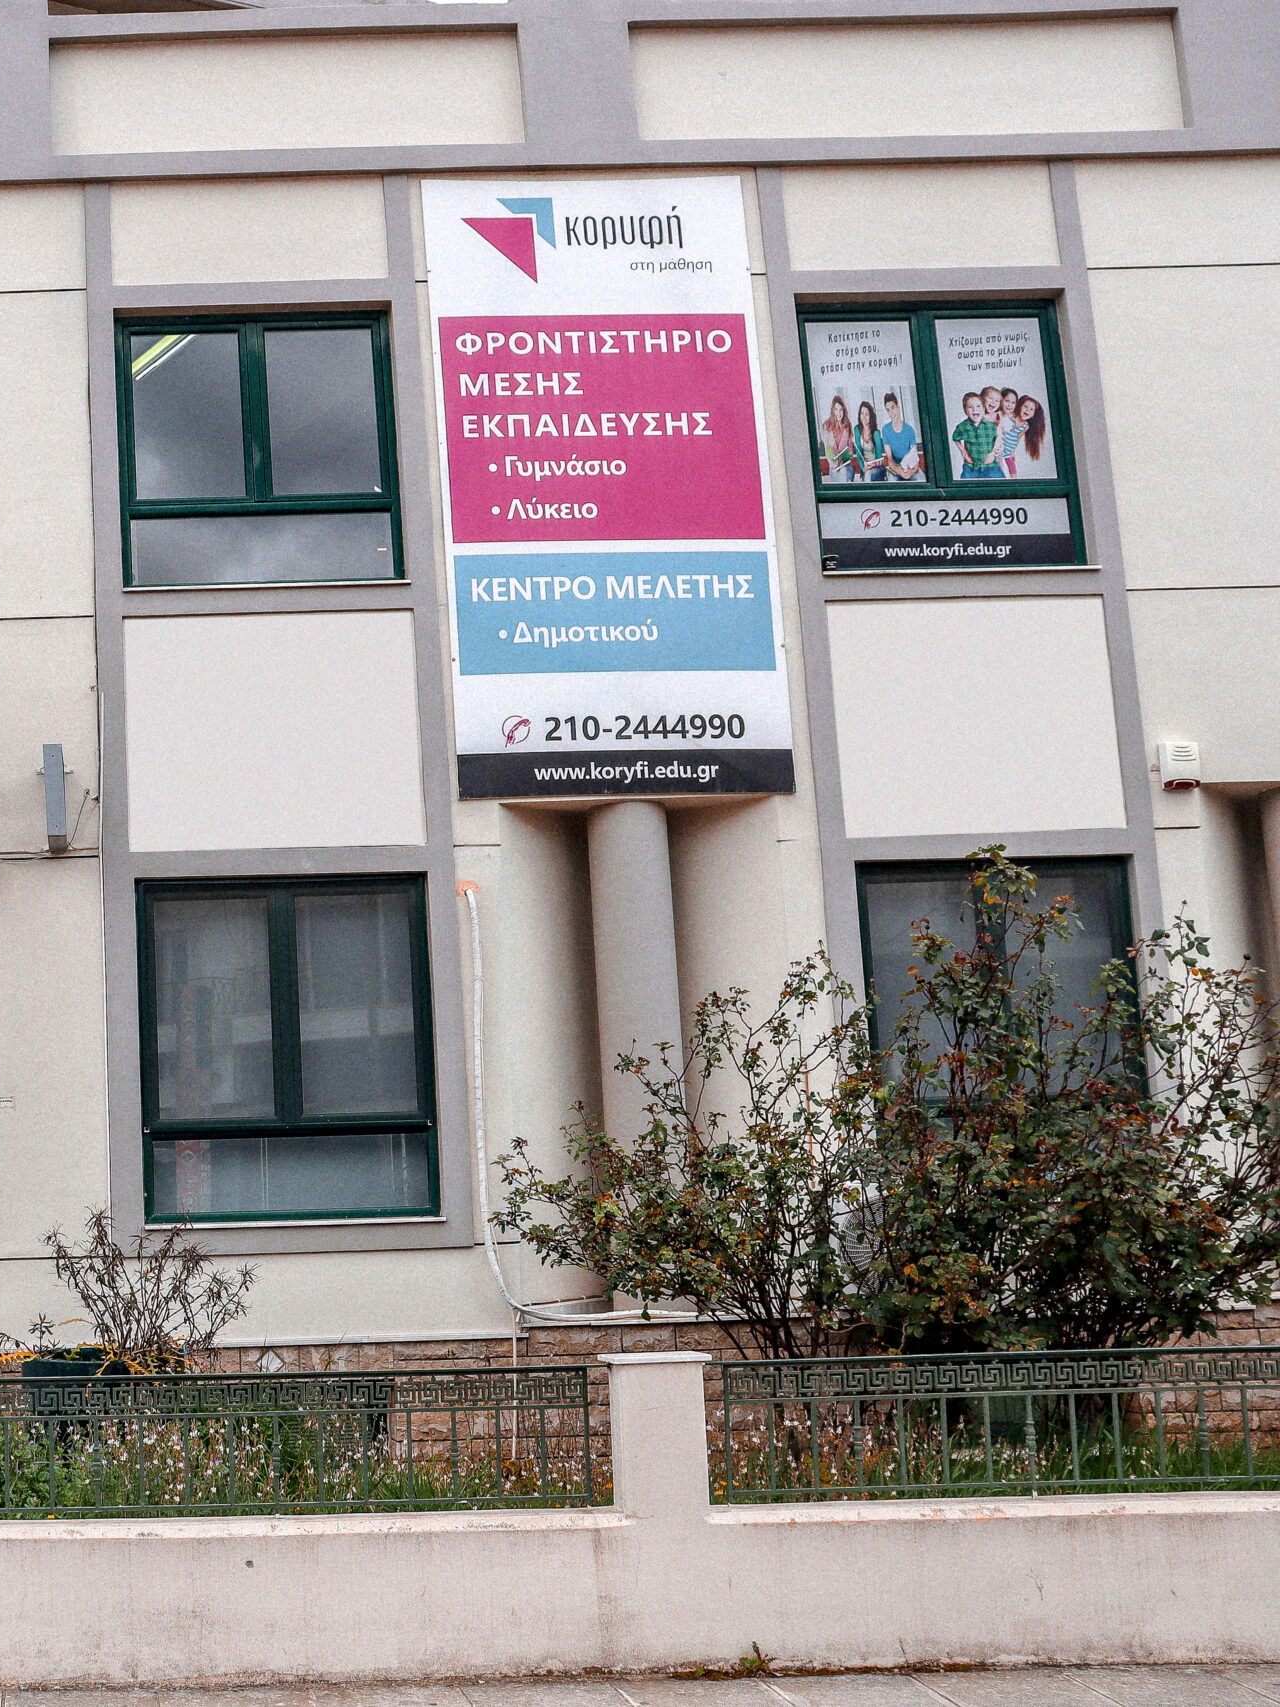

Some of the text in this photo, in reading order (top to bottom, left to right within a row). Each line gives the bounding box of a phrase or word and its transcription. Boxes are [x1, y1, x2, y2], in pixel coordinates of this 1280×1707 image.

[564, 205, 683, 250] κορυφή
[629, 258, 713, 273] στη μάθηση
[454, 329, 732, 356] ΦΡΟΝΤΙΣΤΗΡΙΟ
[827, 329, 881, 343] Κατέκτησε το
[948, 336, 983, 348] Χτίζουμε
[985, 333, 1002, 344] από
[835, 345, 860, 358] στόχο
[957, 344, 1026, 360] σωστά το μέλλον
[820, 361, 844, 376] φτάσε
[847, 361, 866, 371] στην
[967, 363, 983, 372] των
[459, 371, 584, 397] ΜΕΣΗΣ
[461, 411, 713, 439] ΕΚΠΑΙΔΕΥΣΗΣ
[504, 453, 628, 481] Γυμνάσιο
[507, 498, 599, 521] Λύκειο
[890, 507, 1029, 528] 210-2444990
[884, 542, 1012, 559] www.koryfi.edu.gr
[470, 574, 755, 602] ΚΕΝΤΡΟ ΜΕΛΕΤΗΣ
[513, 618, 659, 648] Δημοτικού
[544, 713, 746, 742] 210-2444990
[533, 760, 720, 782] www.koryfi.edu.gr
